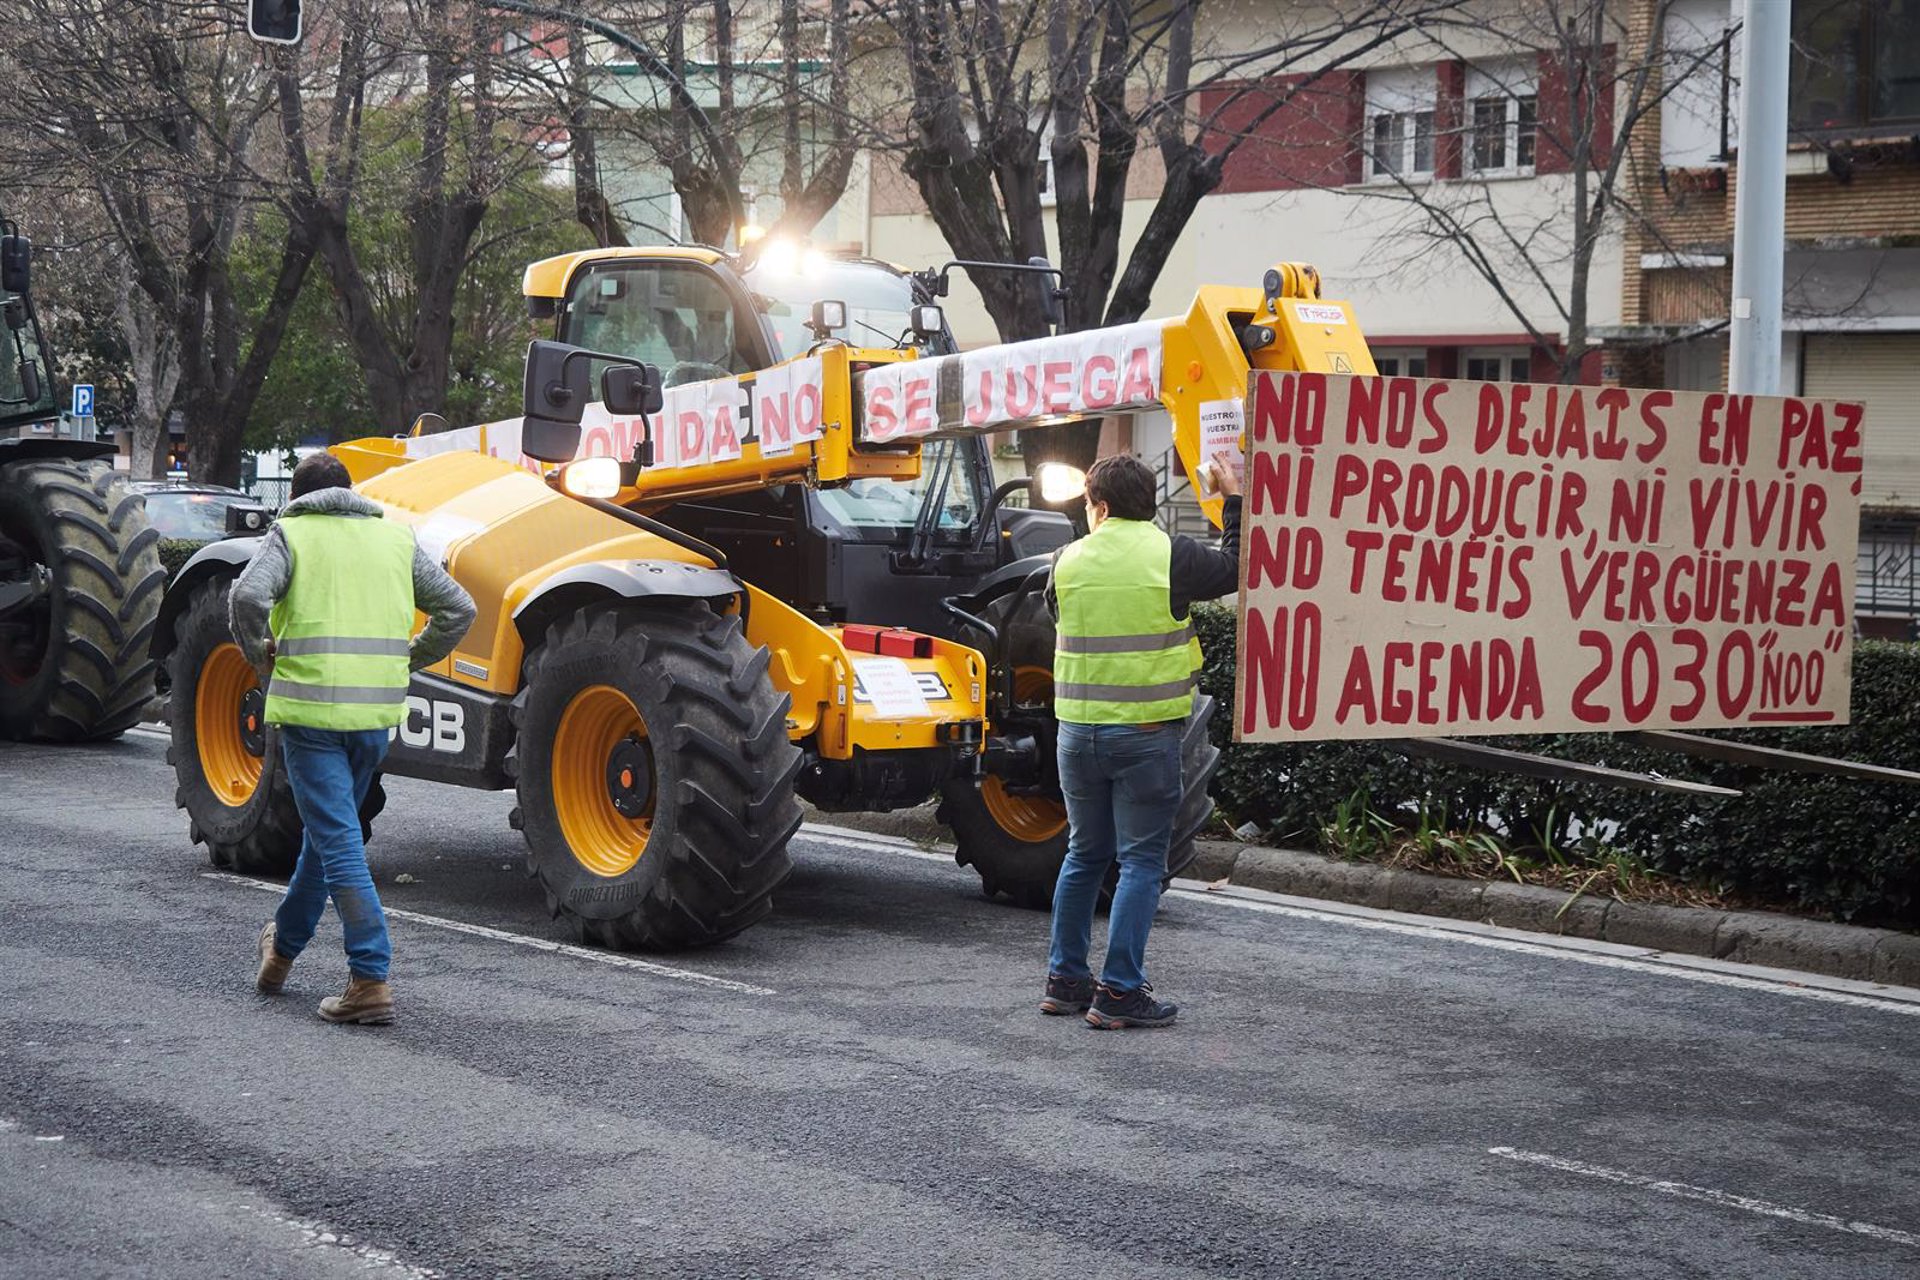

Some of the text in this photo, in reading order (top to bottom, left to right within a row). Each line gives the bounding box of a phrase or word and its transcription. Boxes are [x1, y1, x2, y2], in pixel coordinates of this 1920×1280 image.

[78, 389, 90, 413] P
[575, 405, 741, 464] OMIDA
[760, 383, 821, 446] NO
[866, 378, 932, 438] SE
[965, 347, 1156, 426] JUEGA
[1254, 371, 1327, 446] NO
[1346, 376, 1449, 453] NOS
[1475, 384, 1673, 463] DEJAIS
[1700, 394, 1753, 466] EN
[1246, 526, 1323, 590] NO
[1244, 602, 1321, 734] NO
[1335, 637, 1543, 725] AGENDA
[1572, 629, 1755, 723] 2030
[388, 696, 465, 752] CB
